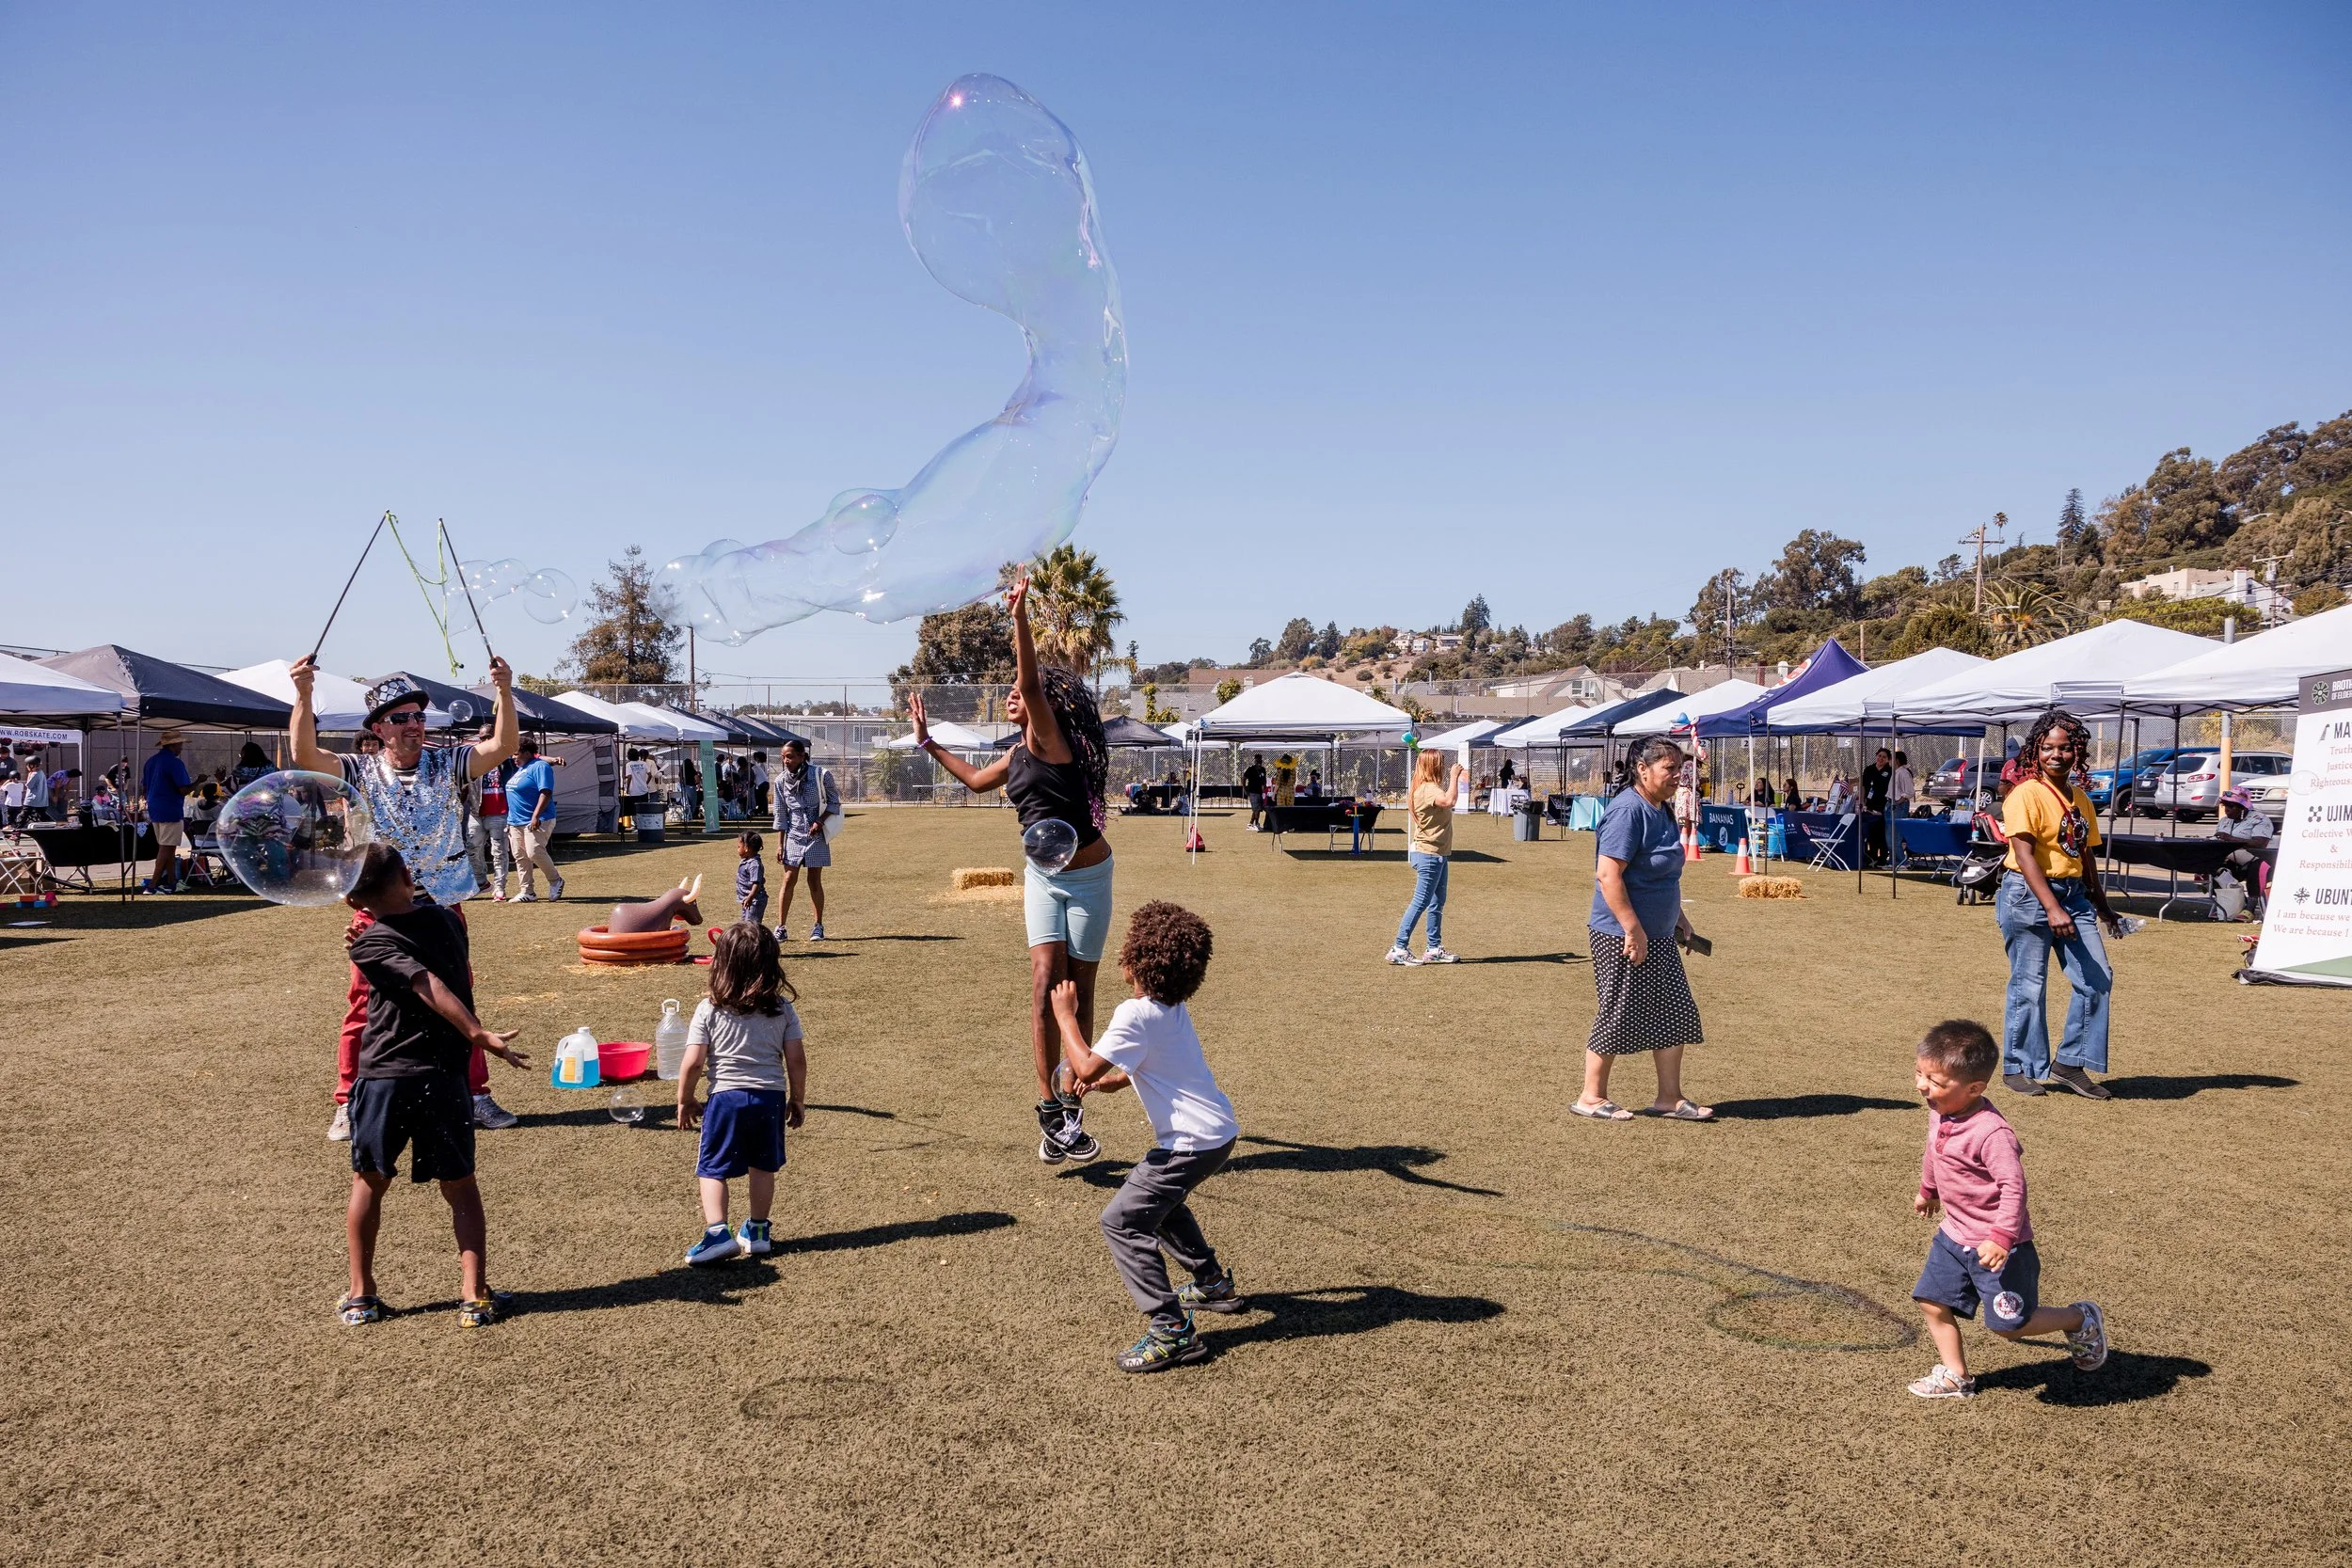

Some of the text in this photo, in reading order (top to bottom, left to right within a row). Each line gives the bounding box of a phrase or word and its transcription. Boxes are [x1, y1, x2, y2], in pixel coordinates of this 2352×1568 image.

[2311, 777, 2352, 789] Righteous
[1709, 813, 1734, 825] BANANAS
[2301, 829, 2344, 838] Collective
[2330, 845, 2338, 853] &
[2277, 910, 2281, 918] I
[2299, 911, 2335, 921] because
[2273, 924, 2287, 933] We
[2306, 926, 2343, 937] because
